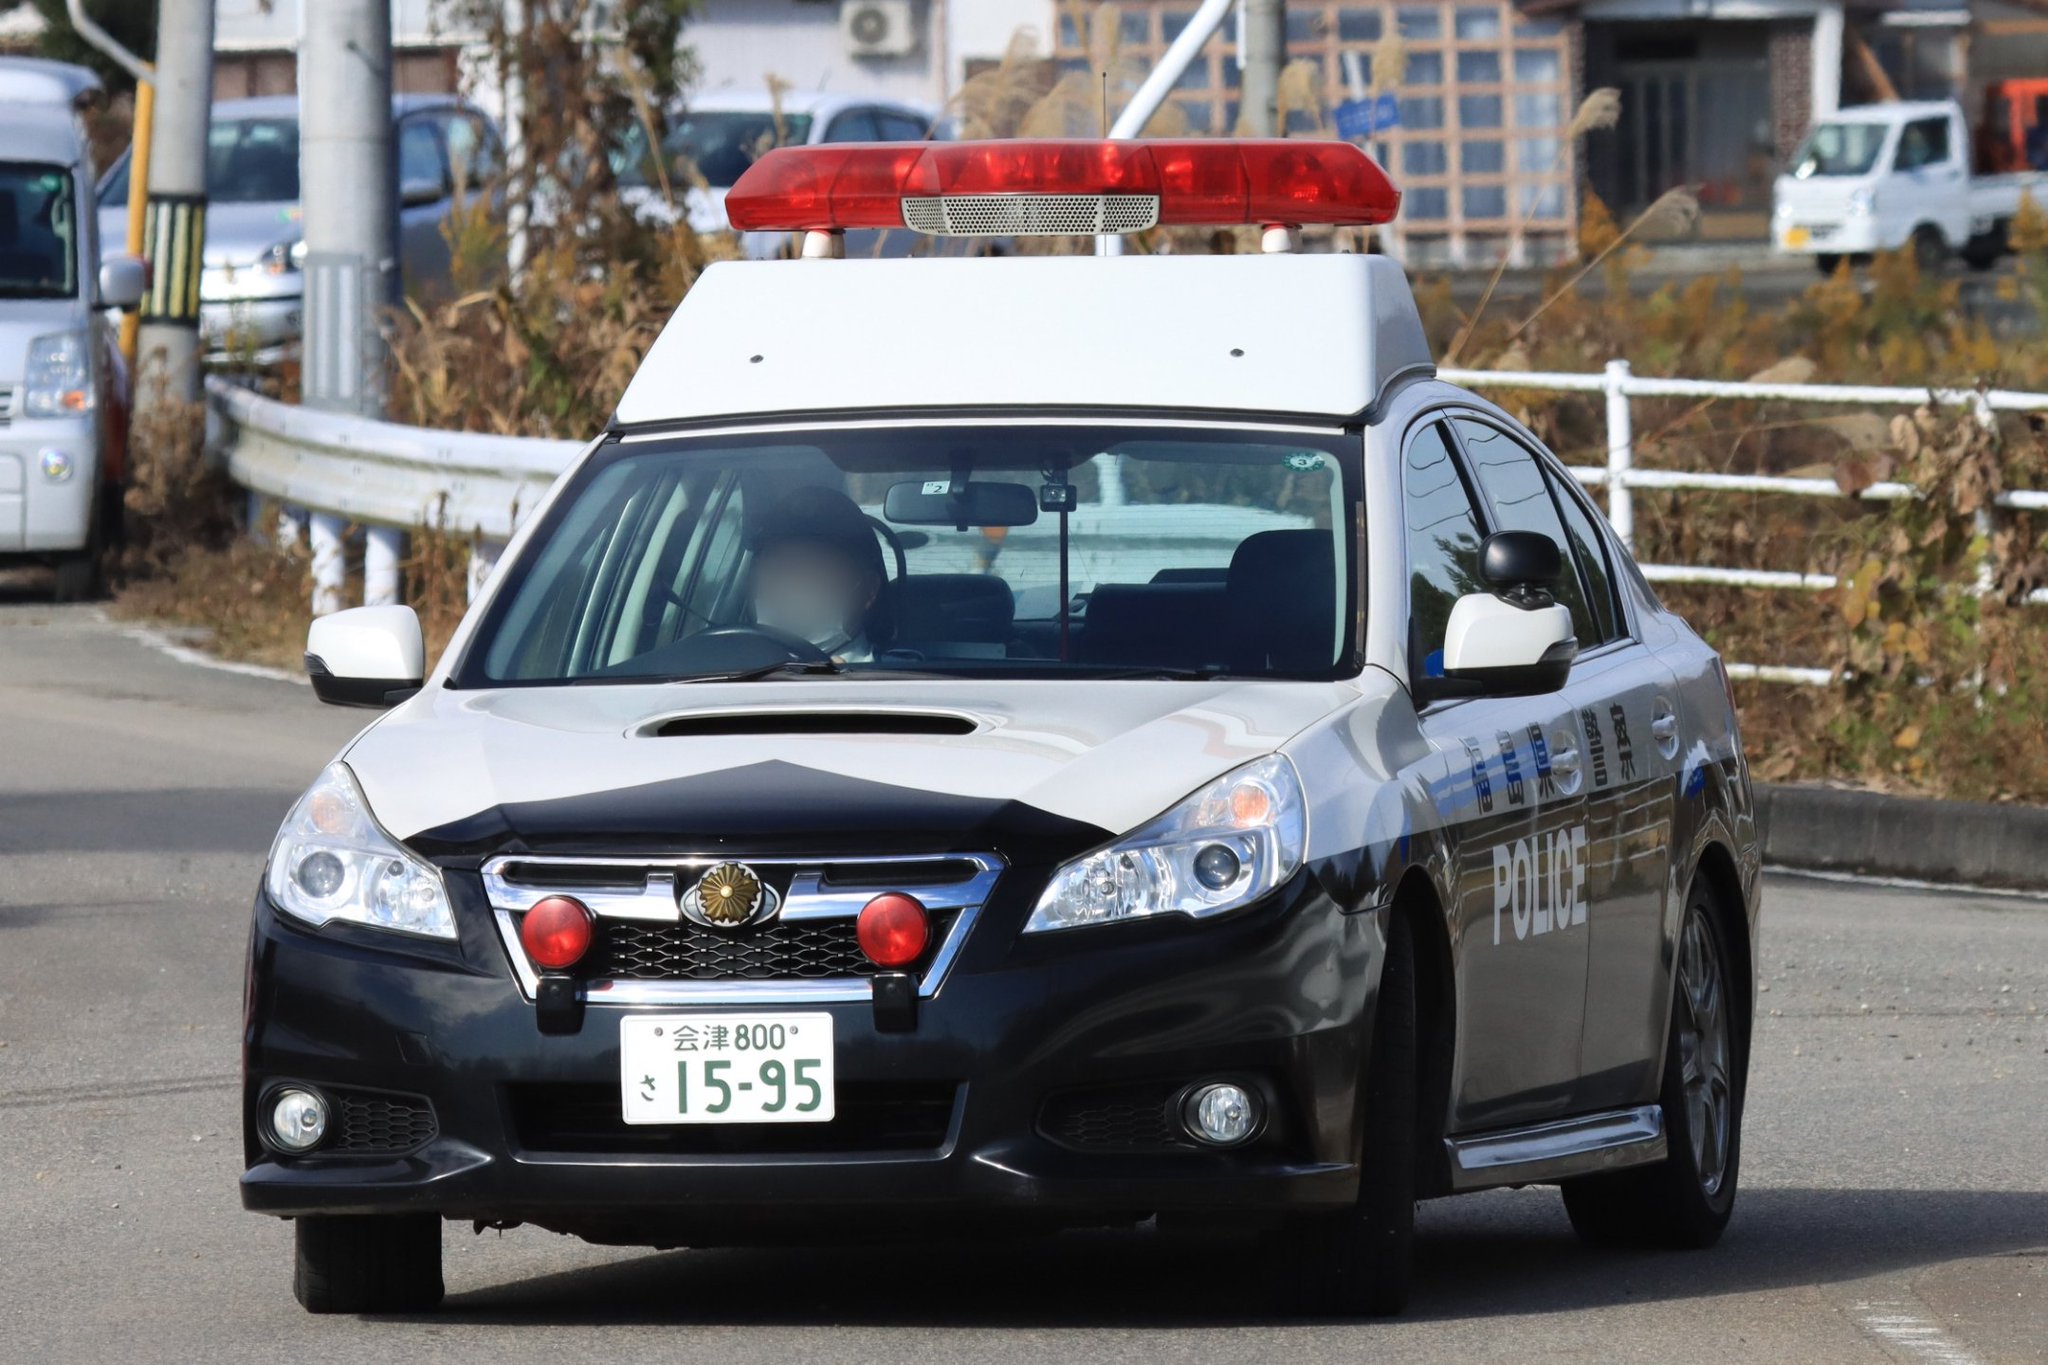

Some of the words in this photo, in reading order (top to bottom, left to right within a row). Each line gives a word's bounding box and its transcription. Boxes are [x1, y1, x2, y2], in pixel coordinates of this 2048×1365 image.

[1493, 825, 1587, 946] POLICE
[639, 1074, 656, 1102] さ
[677, 1058, 822, 1114] 15-95
